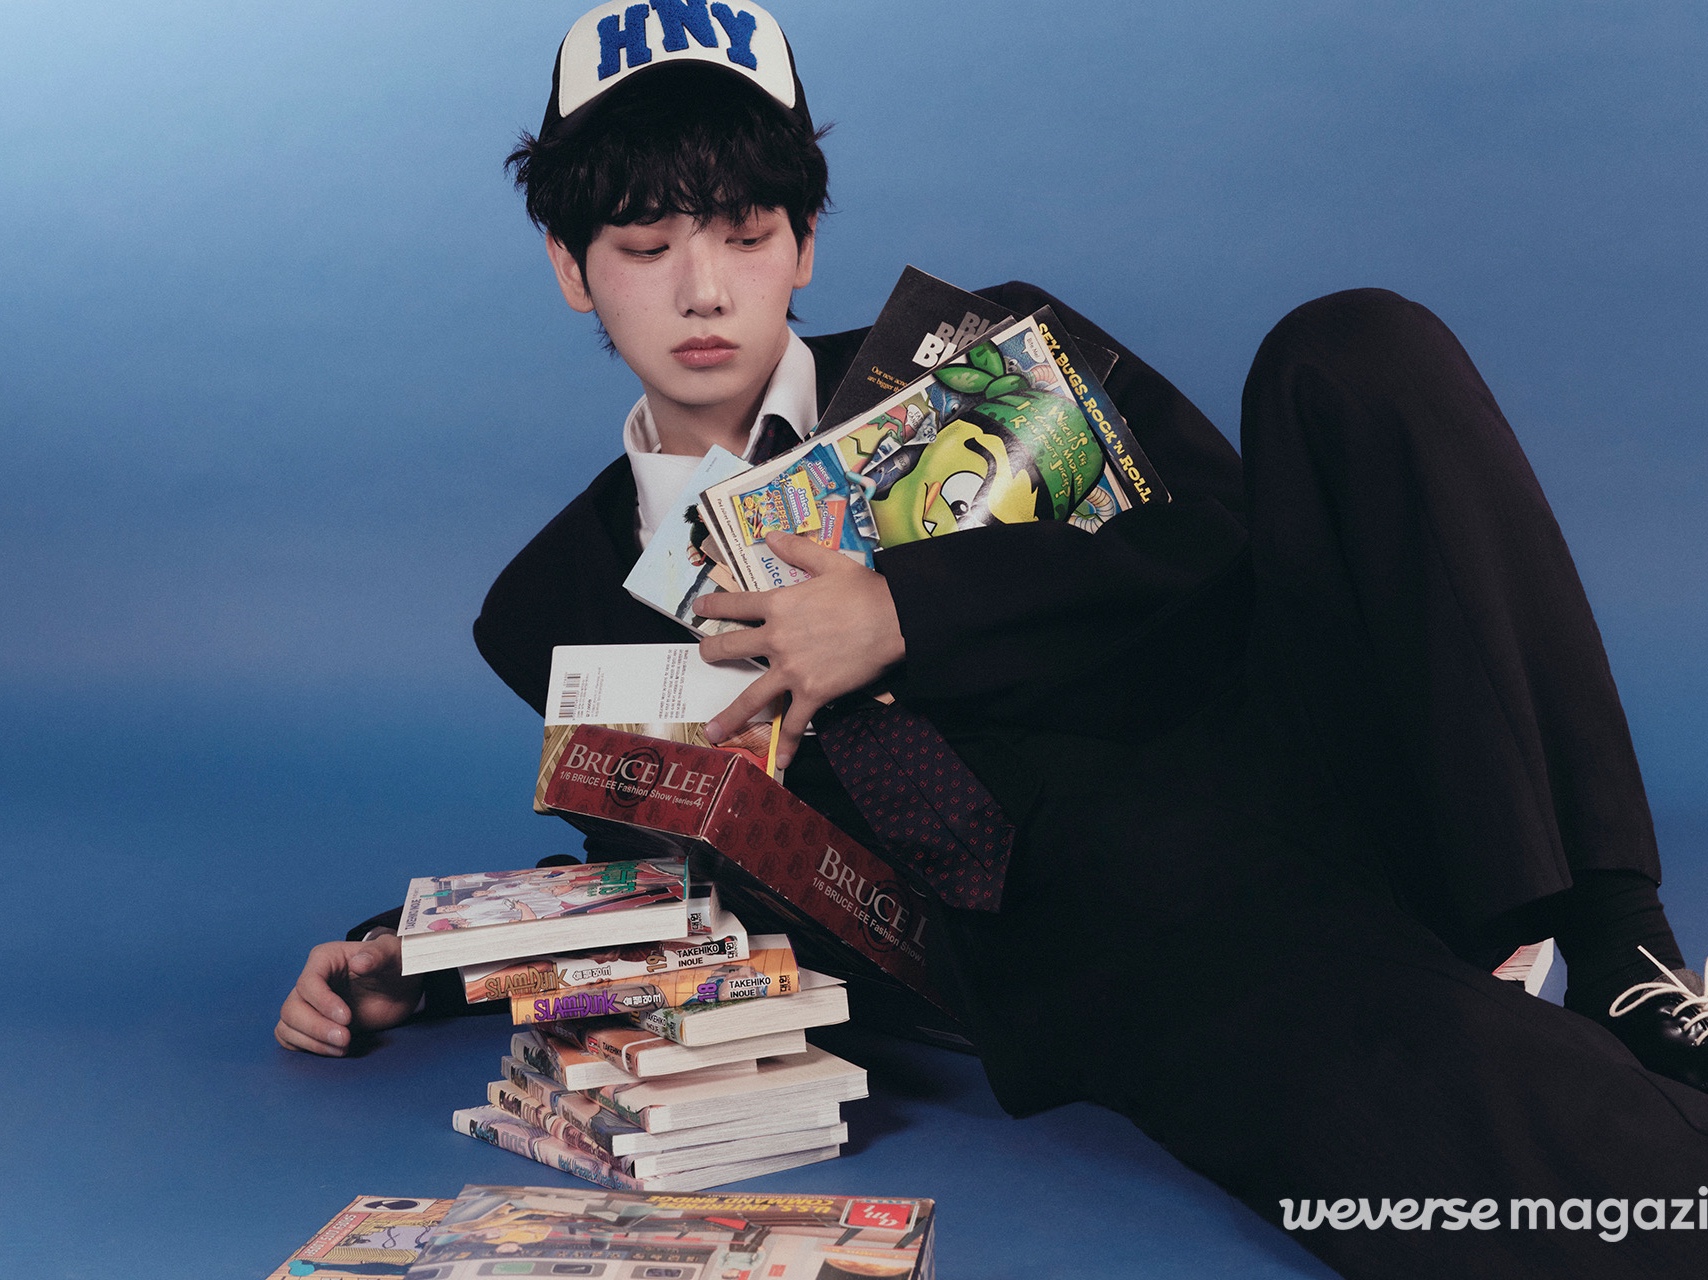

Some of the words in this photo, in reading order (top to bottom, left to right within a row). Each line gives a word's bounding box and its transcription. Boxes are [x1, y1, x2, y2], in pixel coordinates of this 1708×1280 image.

[597, 0, 757, 81] HNY
[911, 332, 958, 368] BI
[1083, 397, 1118, 444] ROCK
[1119, 455, 1152, 503] ROLL
[797, 487, 811, 517] Juicee
[564, 743, 659, 784] BRUCE
[661, 761, 715, 796] LEE
[560, 770, 571, 780] 1/6
[571, 773, 600, 786] BRUCE
[600, 779, 617, 790] LEE
[617, 782, 649, 797] Fashion
[650, 789, 672, 801] Show
[817, 843, 910, 933] BRUCE
[812, 877, 824, 891] 1/6
[824, 885, 853, 912] BRUCE
[853, 906, 870, 925] LEE
[870, 919, 900, 947] Fashion
[900, 941, 922, 961] Show
[646, 954, 667, 973] 19
[677, 944, 719, 959] TAKEHIKO
[678, 957, 704, 967] INOUE
[698, 983, 718, 1001] 18
[729, 976, 772, 989] TAKEHIKO
[730, 989, 756, 999] INOUE
[646, 1195, 719, 1204] BRIDGE
[722, 1198, 834, 1206] COMMAND
